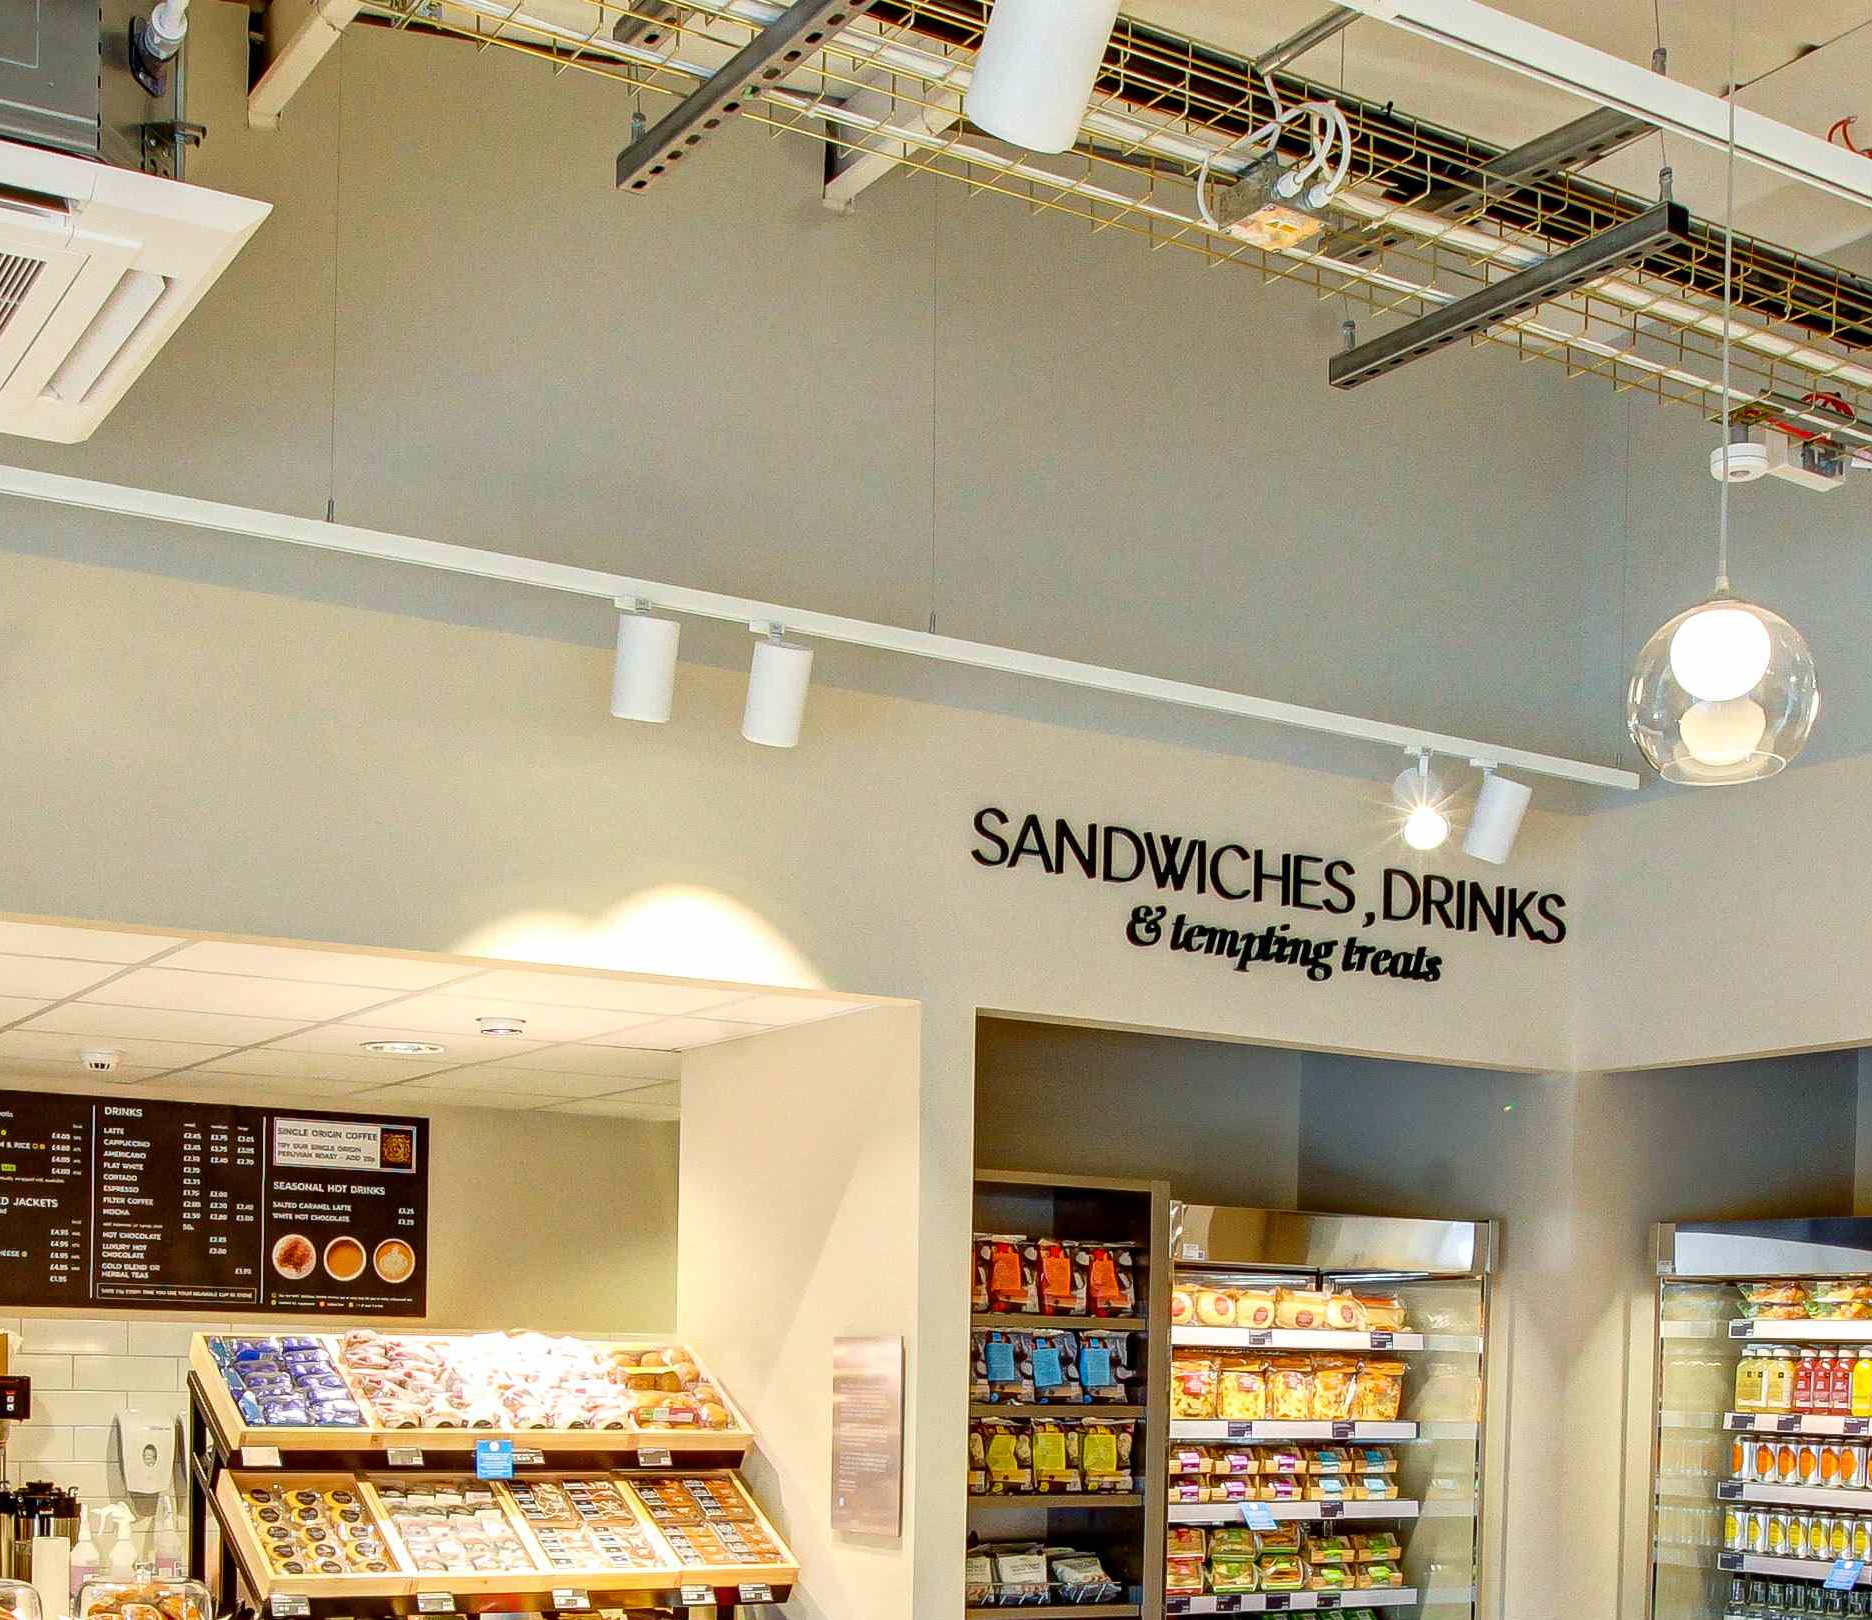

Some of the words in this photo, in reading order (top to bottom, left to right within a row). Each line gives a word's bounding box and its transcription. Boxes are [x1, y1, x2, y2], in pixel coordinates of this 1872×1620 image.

[1382, 866, 1568, 945] DRINKS
[1125, 904, 1169, 947] &
[1170, 913, 1338, 982] tempting
[1340, 936, 1443, 983] treats
[104, 1107, 143, 1118] DRINKS
[278, 1127, 309, 1137] SINGLE
[312, 1129, 342, 1138] ORIGIN
[345, 1131, 378, 1141] COFFEE
[273, 1181, 324, 1192] SEASONAL
[327, 1184, 347, 1193] HOT
[350, 1186, 385, 1196] DRINKS
[13, 1198, 58, 1208] JACKETS
